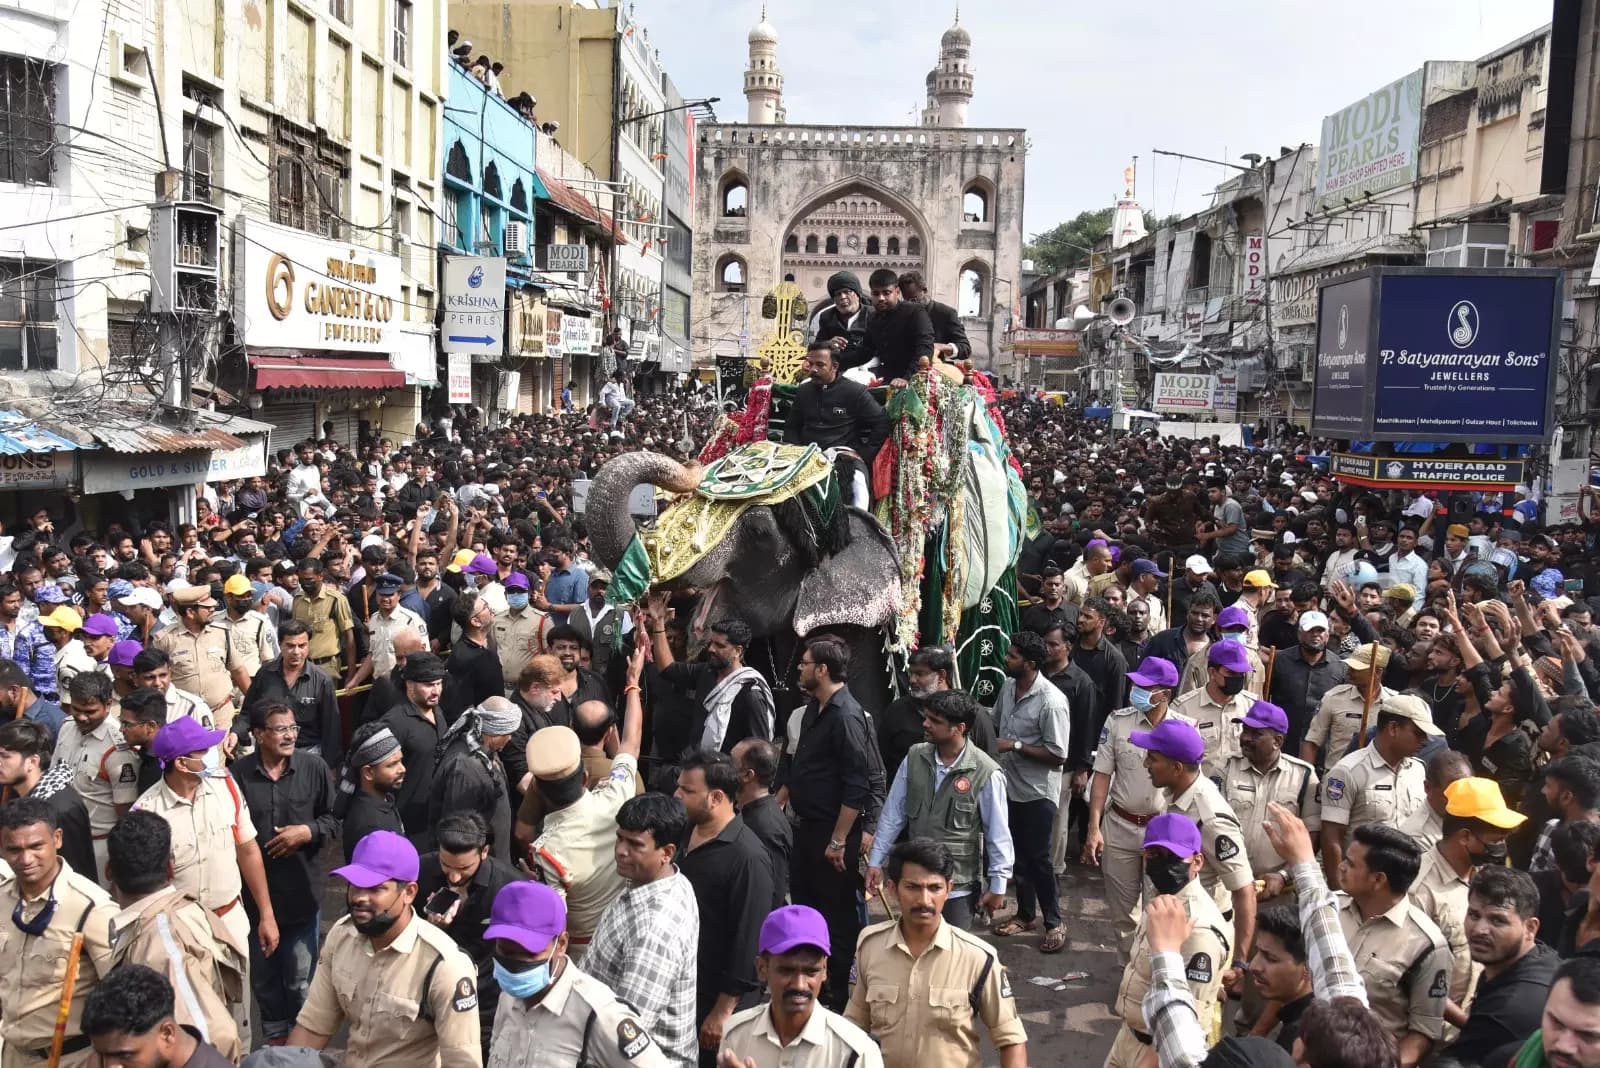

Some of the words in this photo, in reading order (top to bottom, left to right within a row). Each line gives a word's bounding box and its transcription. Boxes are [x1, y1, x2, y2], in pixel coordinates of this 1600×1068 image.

[1328, 81, 1403, 151] MODI
[1328, 127, 1400, 178] PEARLS
[1364, 158, 1388, 178] SHIFTED
[1388, 151, 1406, 169] HERE
[550, 246, 585, 260] MODI
[550, 260, 584, 270] PEARLS
[1248, 237, 1262, 290] MODI
[305, 281, 361, 320] GANESH
[364, 291, 374, 322] &
[375, 295, 394, 324] CO
[448, 293, 498, 309] KRISHNA
[451, 314, 496, 326] PEARLS
[1380, 349, 1395, 365] P.
[1397, 349, 1501, 369] Satyanarayan
[1160, 375, 1211, 390] MODI
[1430, 372, 1490, 381] JEWELLERS
[1159, 388, 1209, 399] PEARLS
[1448, 384, 1456, 392] by
[129, 463, 164, 479] GOLD
[170, 464, 178, 475] &
[184, 458, 228, 474] SILVER
[1340, 456, 1370, 468] HYDERABAD
[1412, 461, 1507, 471] HYDERABAD
[1412, 471, 1461, 480] TRAFFIC
[1463, 473, 1505, 481] POLICE
